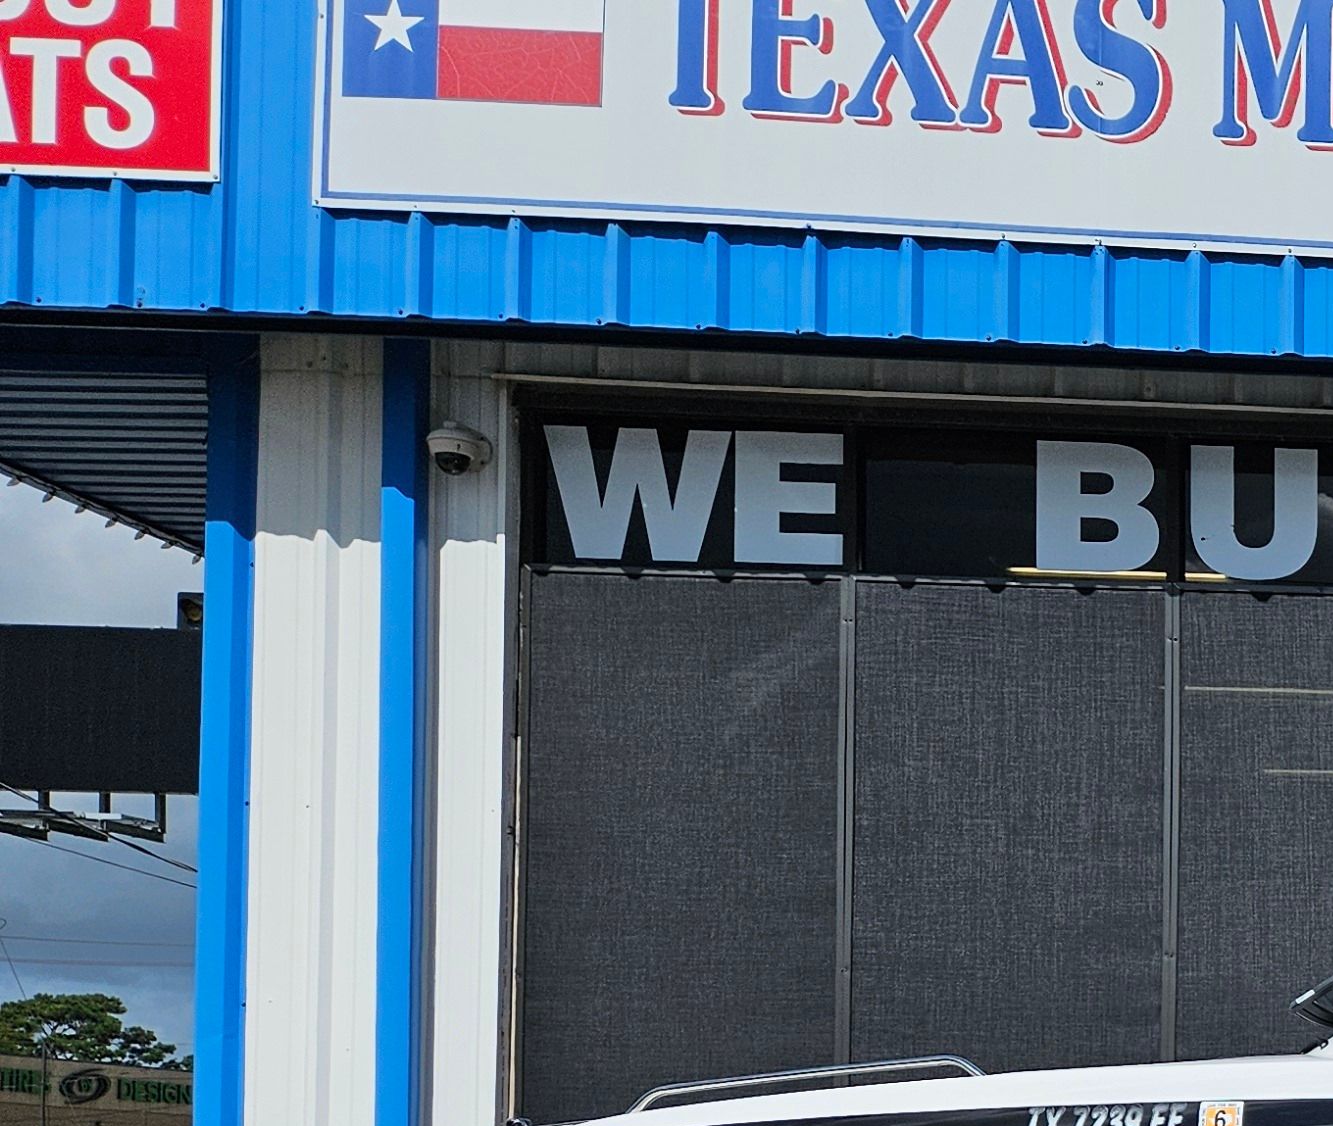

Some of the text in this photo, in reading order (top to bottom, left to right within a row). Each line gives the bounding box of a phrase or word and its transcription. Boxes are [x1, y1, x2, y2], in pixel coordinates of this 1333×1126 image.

[668, 0, 1173, 143] TEXAS
[543, 424, 845, 564] WE
[117, 1078, 193, 1104] DESIGN
